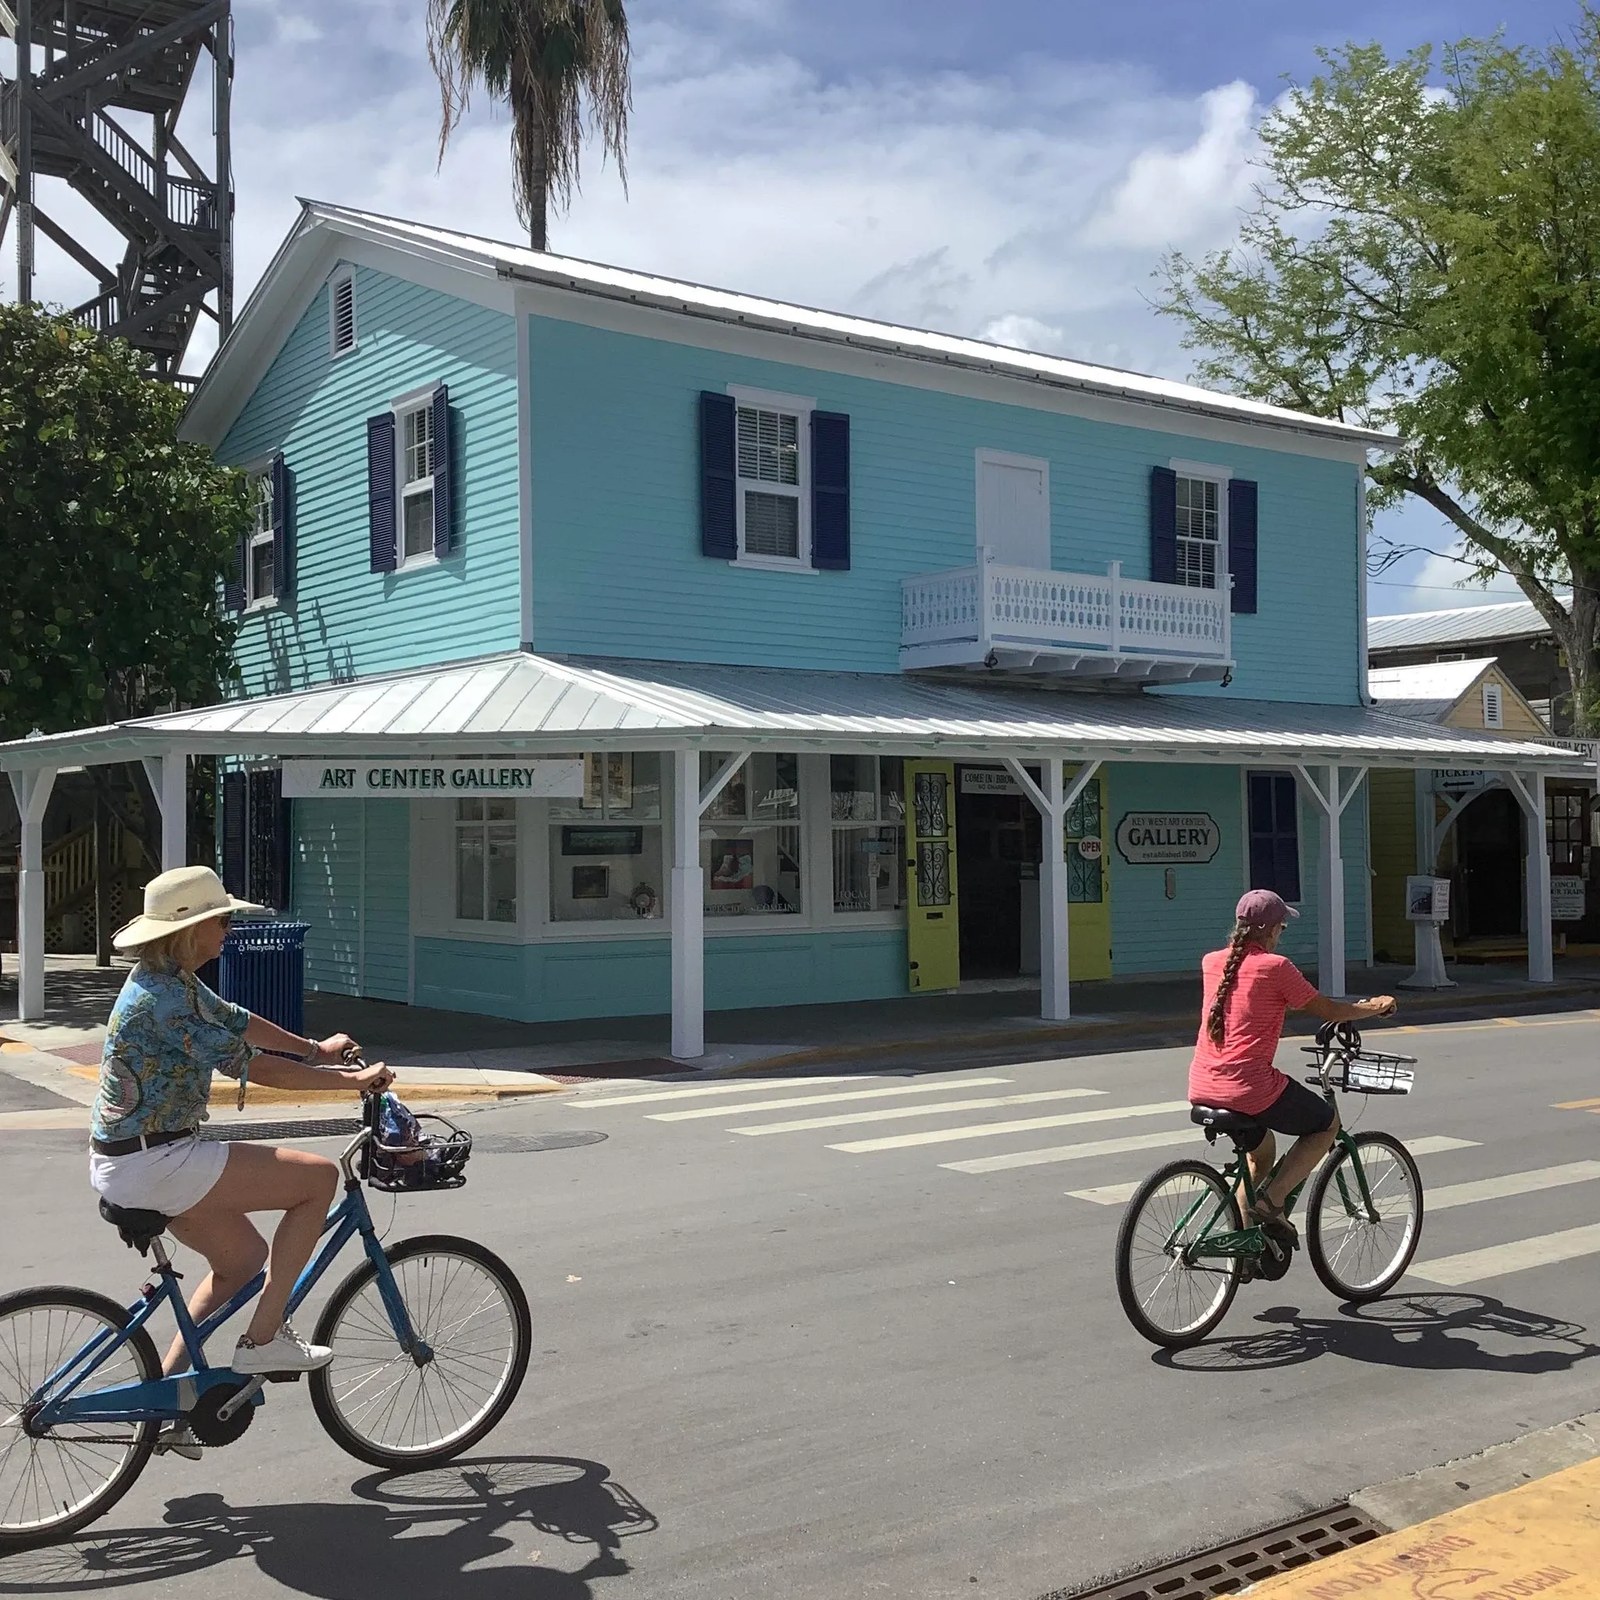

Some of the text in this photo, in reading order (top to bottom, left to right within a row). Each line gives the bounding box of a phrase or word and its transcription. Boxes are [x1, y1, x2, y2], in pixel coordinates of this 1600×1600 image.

[319, 768, 535, 789] ART CENTER GALLERY
[965, 773, 984, 783] COME
[1433, 769, 1483, 778] TICKETS
[1131, 817, 1206, 826] KEY WEST ART CENTER
[1128, 828, 1211, 846] GALLERY
[1081, 841, 1101, 852] OPEN
[246, 944, 276, 953] Recycle
